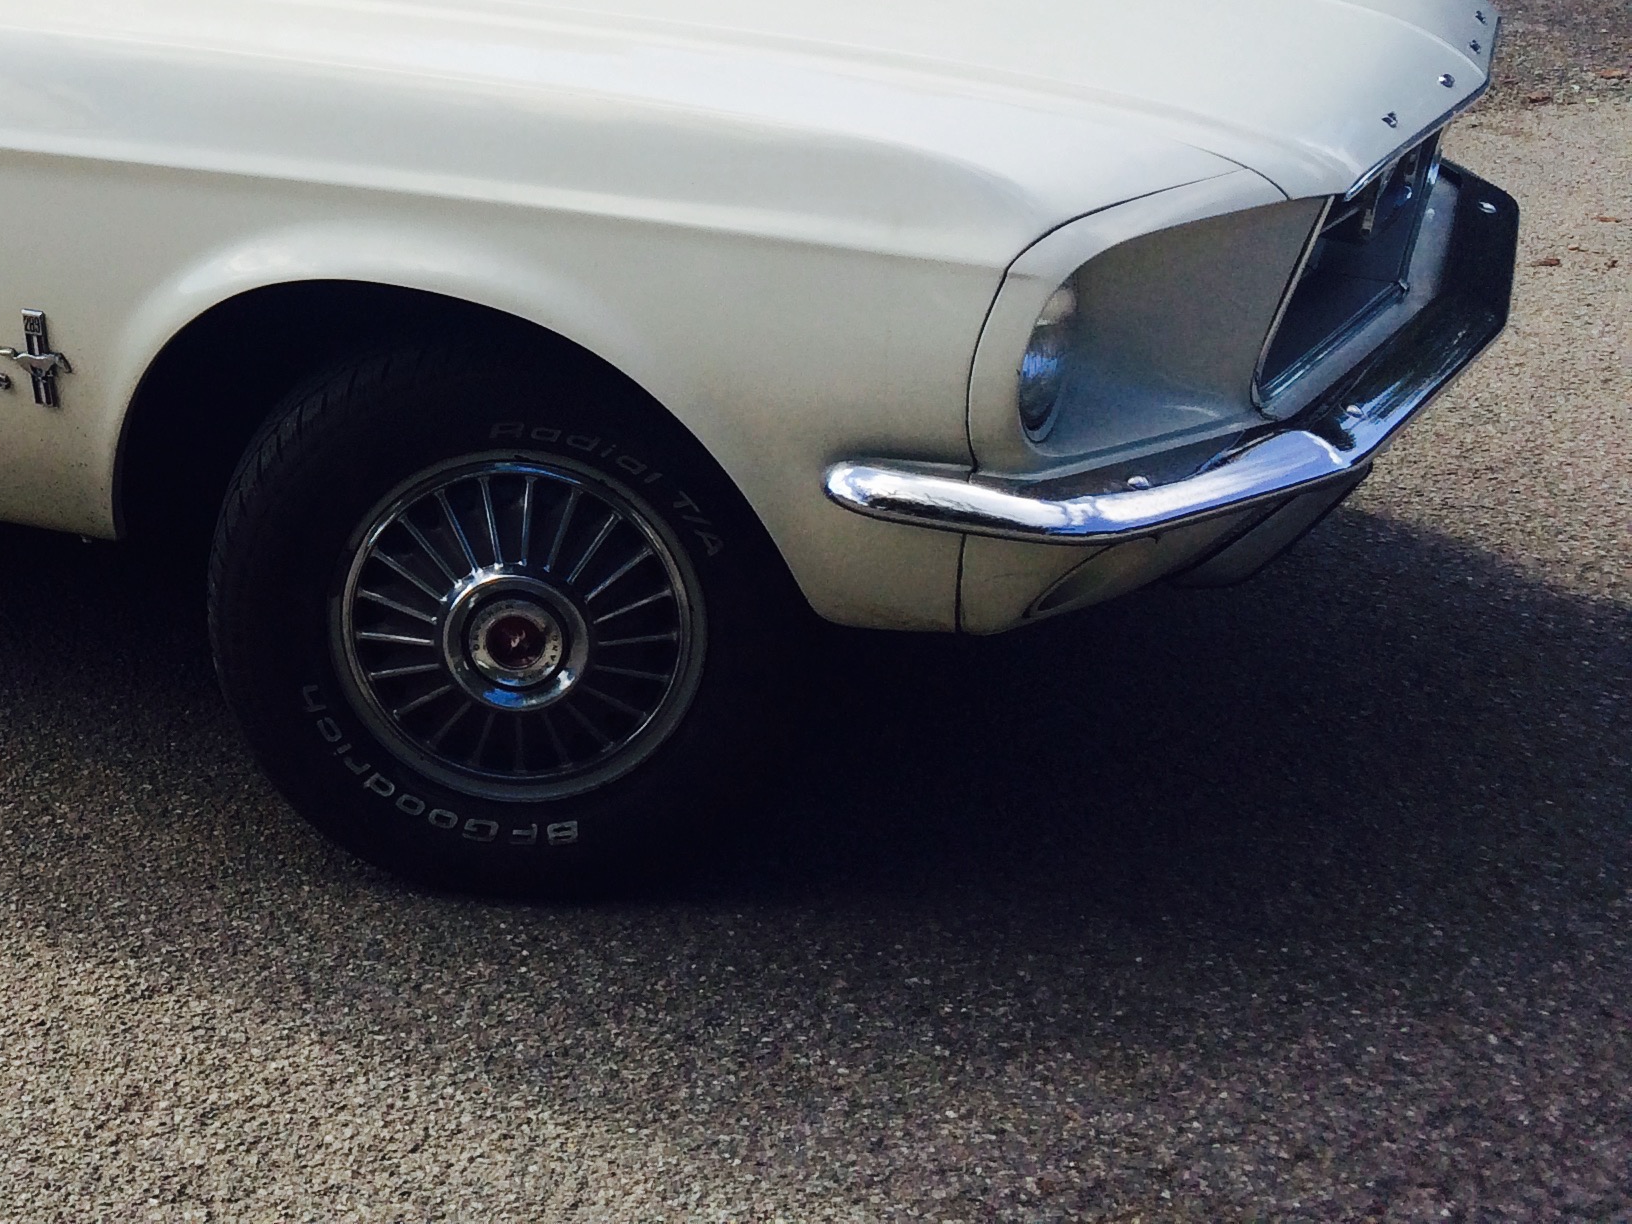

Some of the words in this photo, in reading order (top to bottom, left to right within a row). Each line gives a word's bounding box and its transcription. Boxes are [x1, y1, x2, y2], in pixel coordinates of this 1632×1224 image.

[489, 421, 664, 486] Radial
[672, 489, 725, 556] T/A
[301, 683, 579, 846] BFGoodrich
